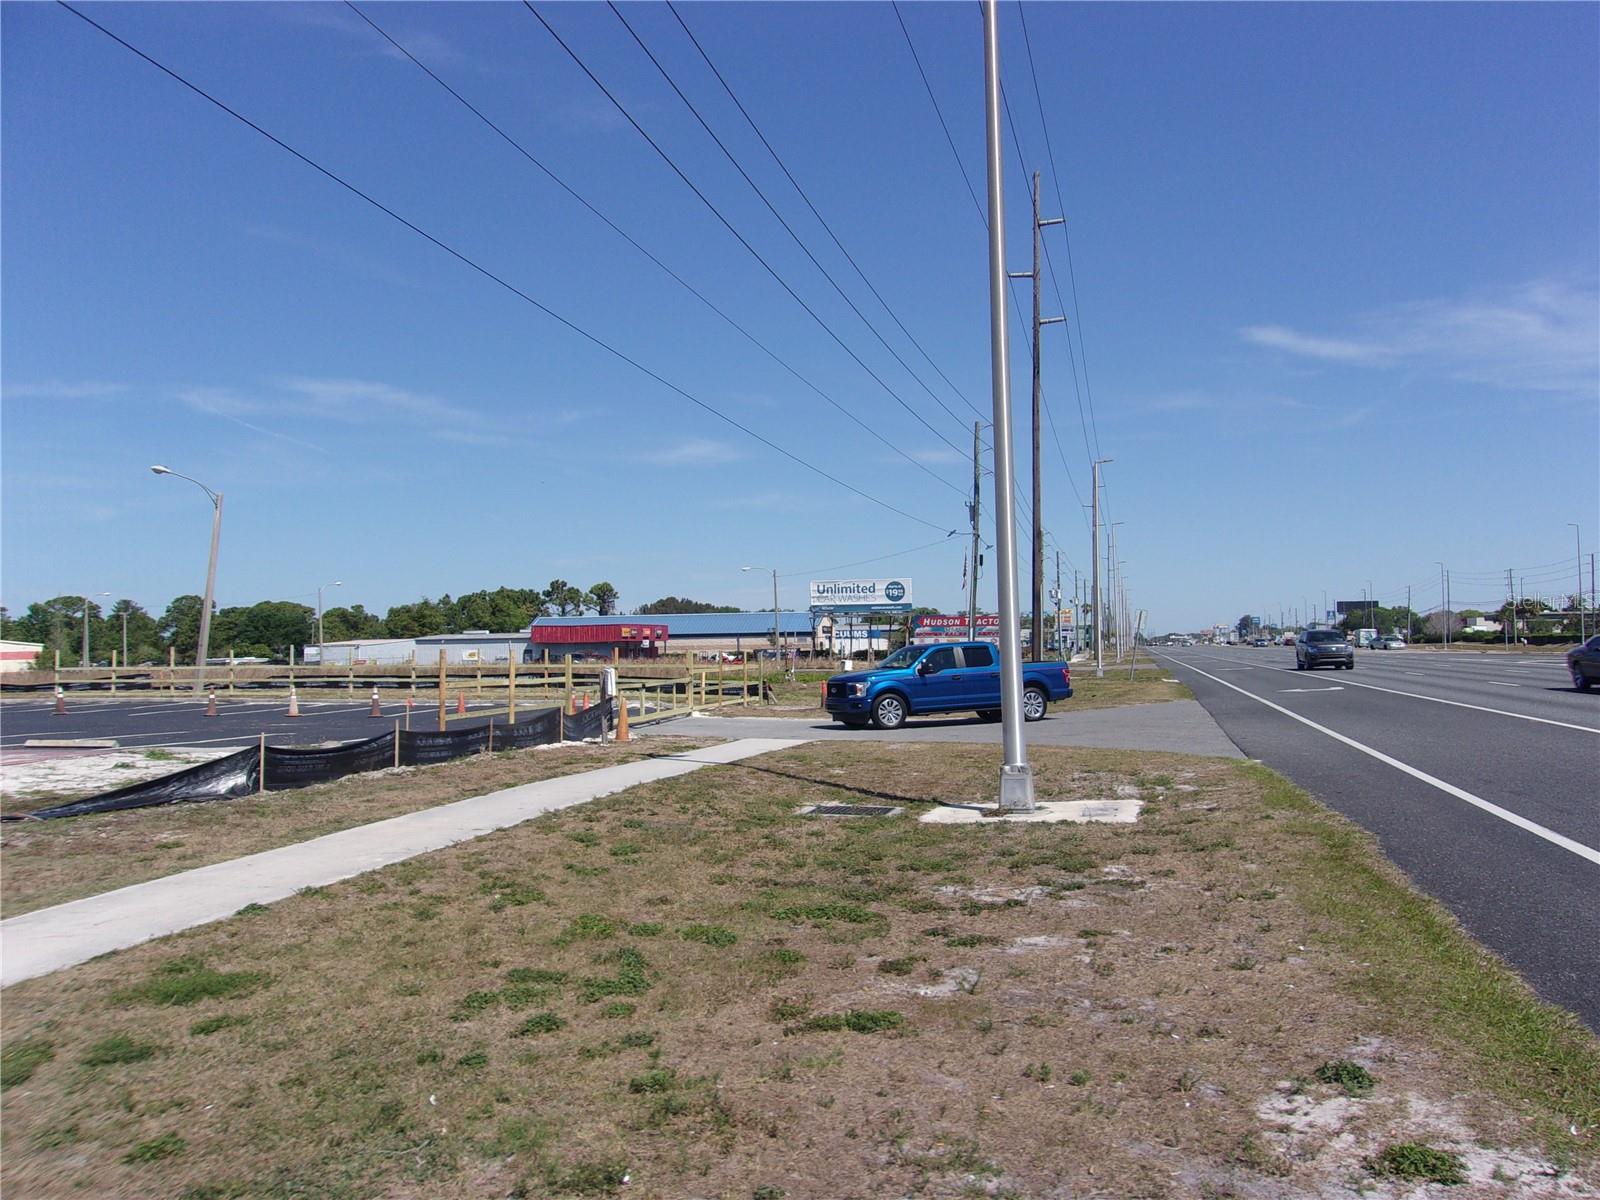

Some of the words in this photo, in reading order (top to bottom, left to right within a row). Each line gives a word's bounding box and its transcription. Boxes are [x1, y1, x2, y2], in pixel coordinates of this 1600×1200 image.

[817, 583, 876, 594] Unlimited
[838, 594, 877, 602] WASHES
[923, 618, 960, 626] HUDSON
[965, 618, 999, 626] TACTO
